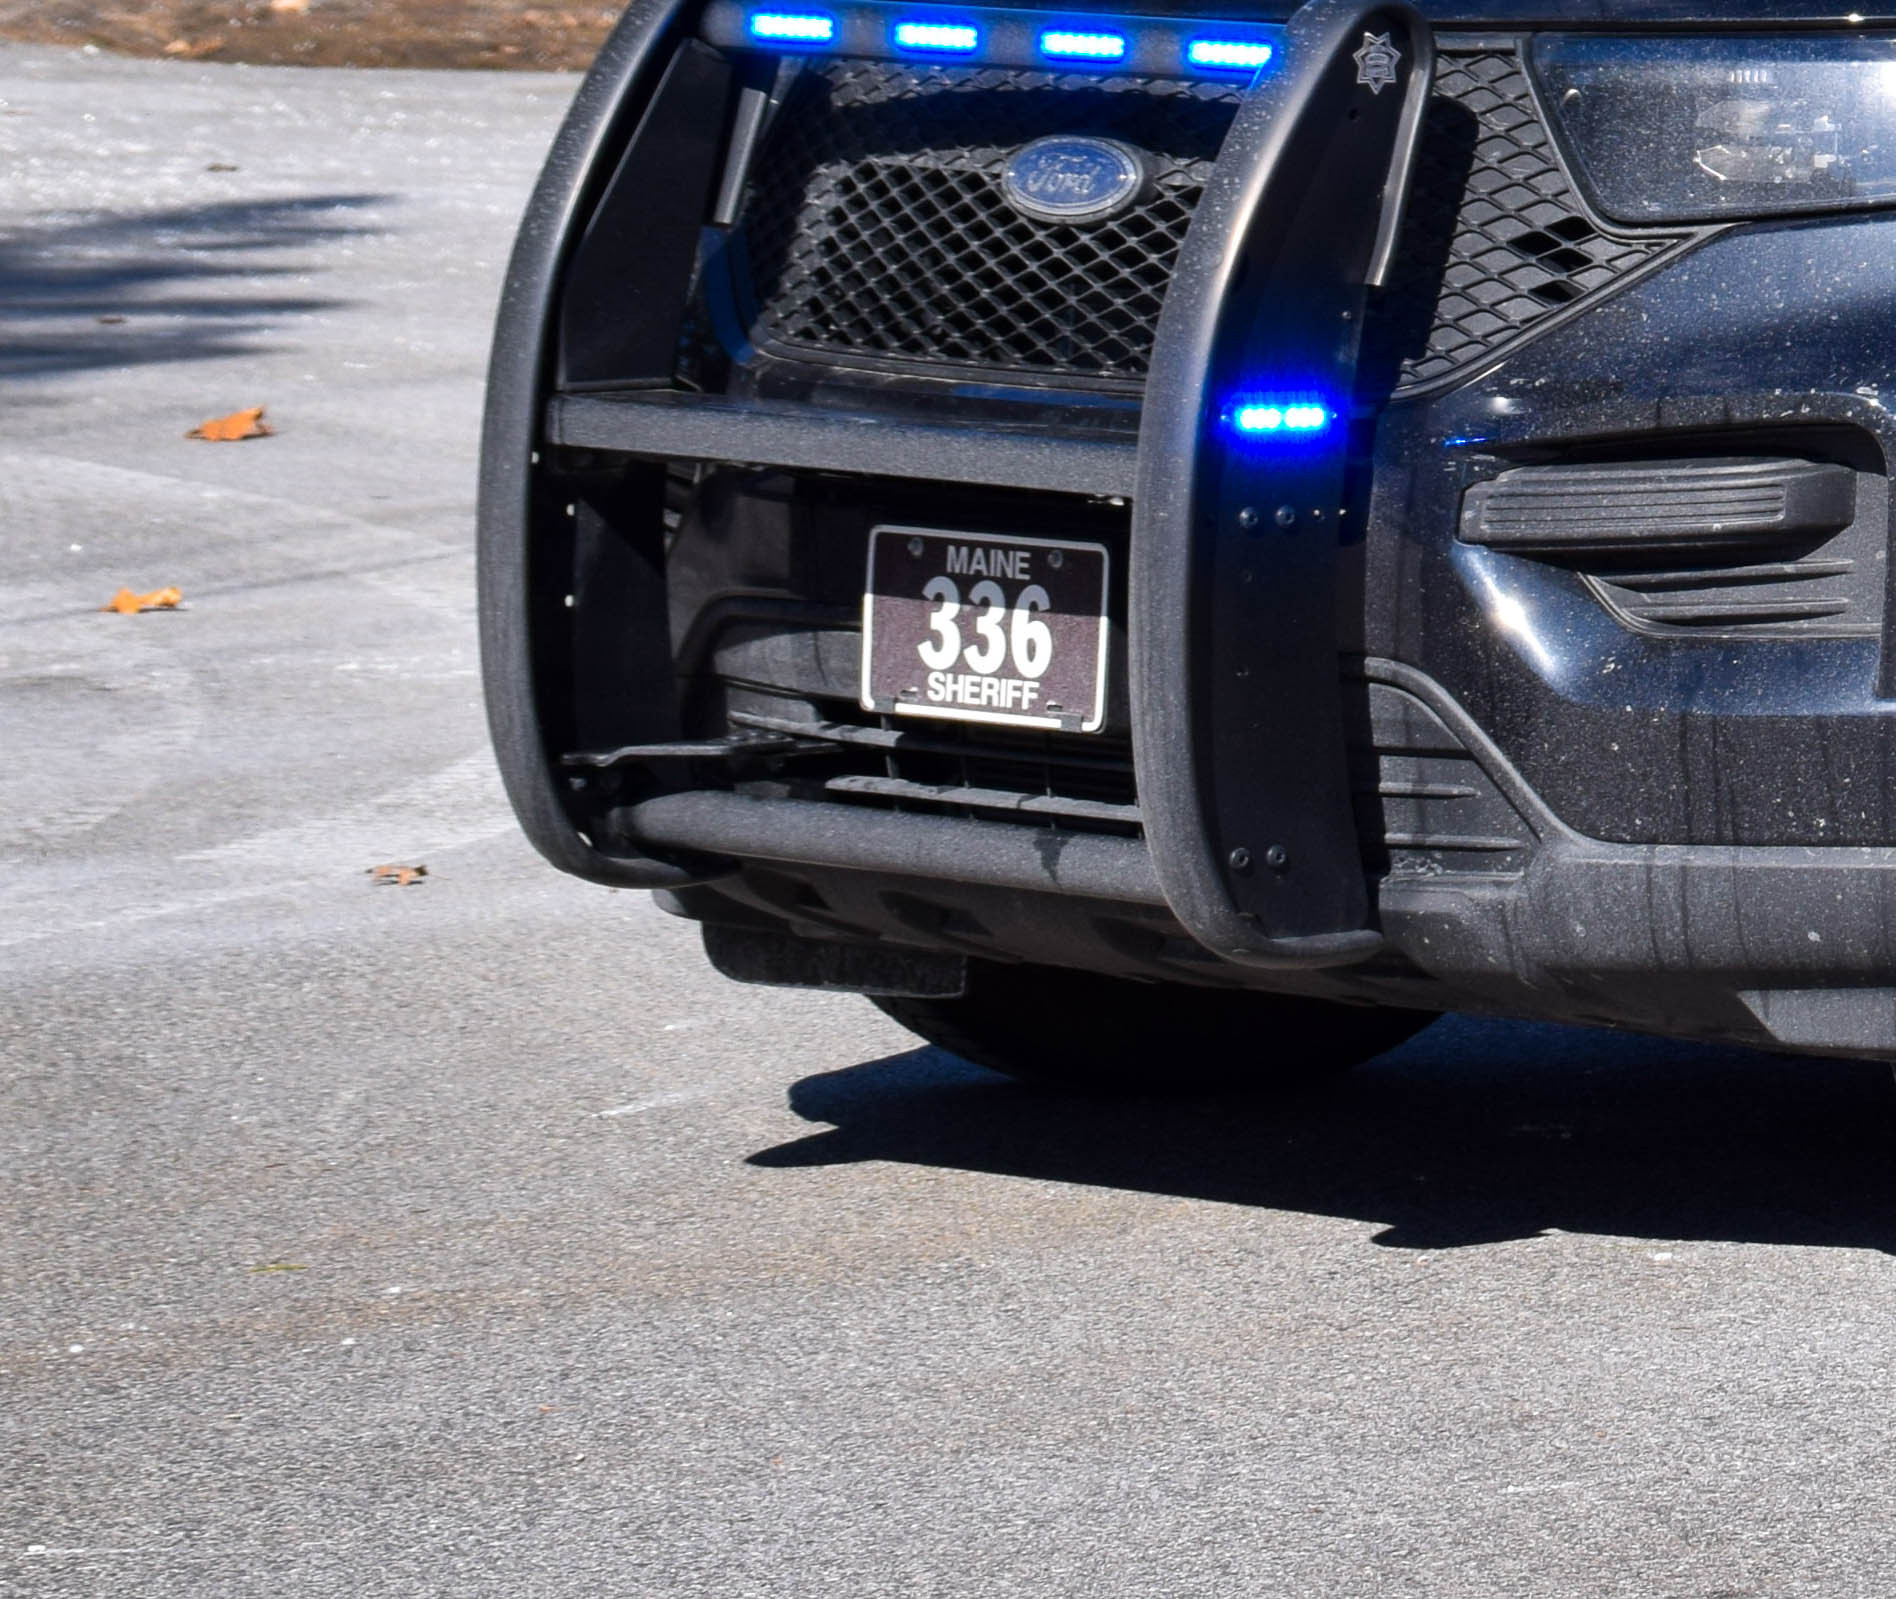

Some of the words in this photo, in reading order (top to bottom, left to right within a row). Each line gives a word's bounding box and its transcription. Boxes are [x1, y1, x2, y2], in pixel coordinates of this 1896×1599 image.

[946, 544, 1032, 581] MAINE
[917, 575, 1053, 679] 336
[927, 671, 1041, 710] SHERIFF
